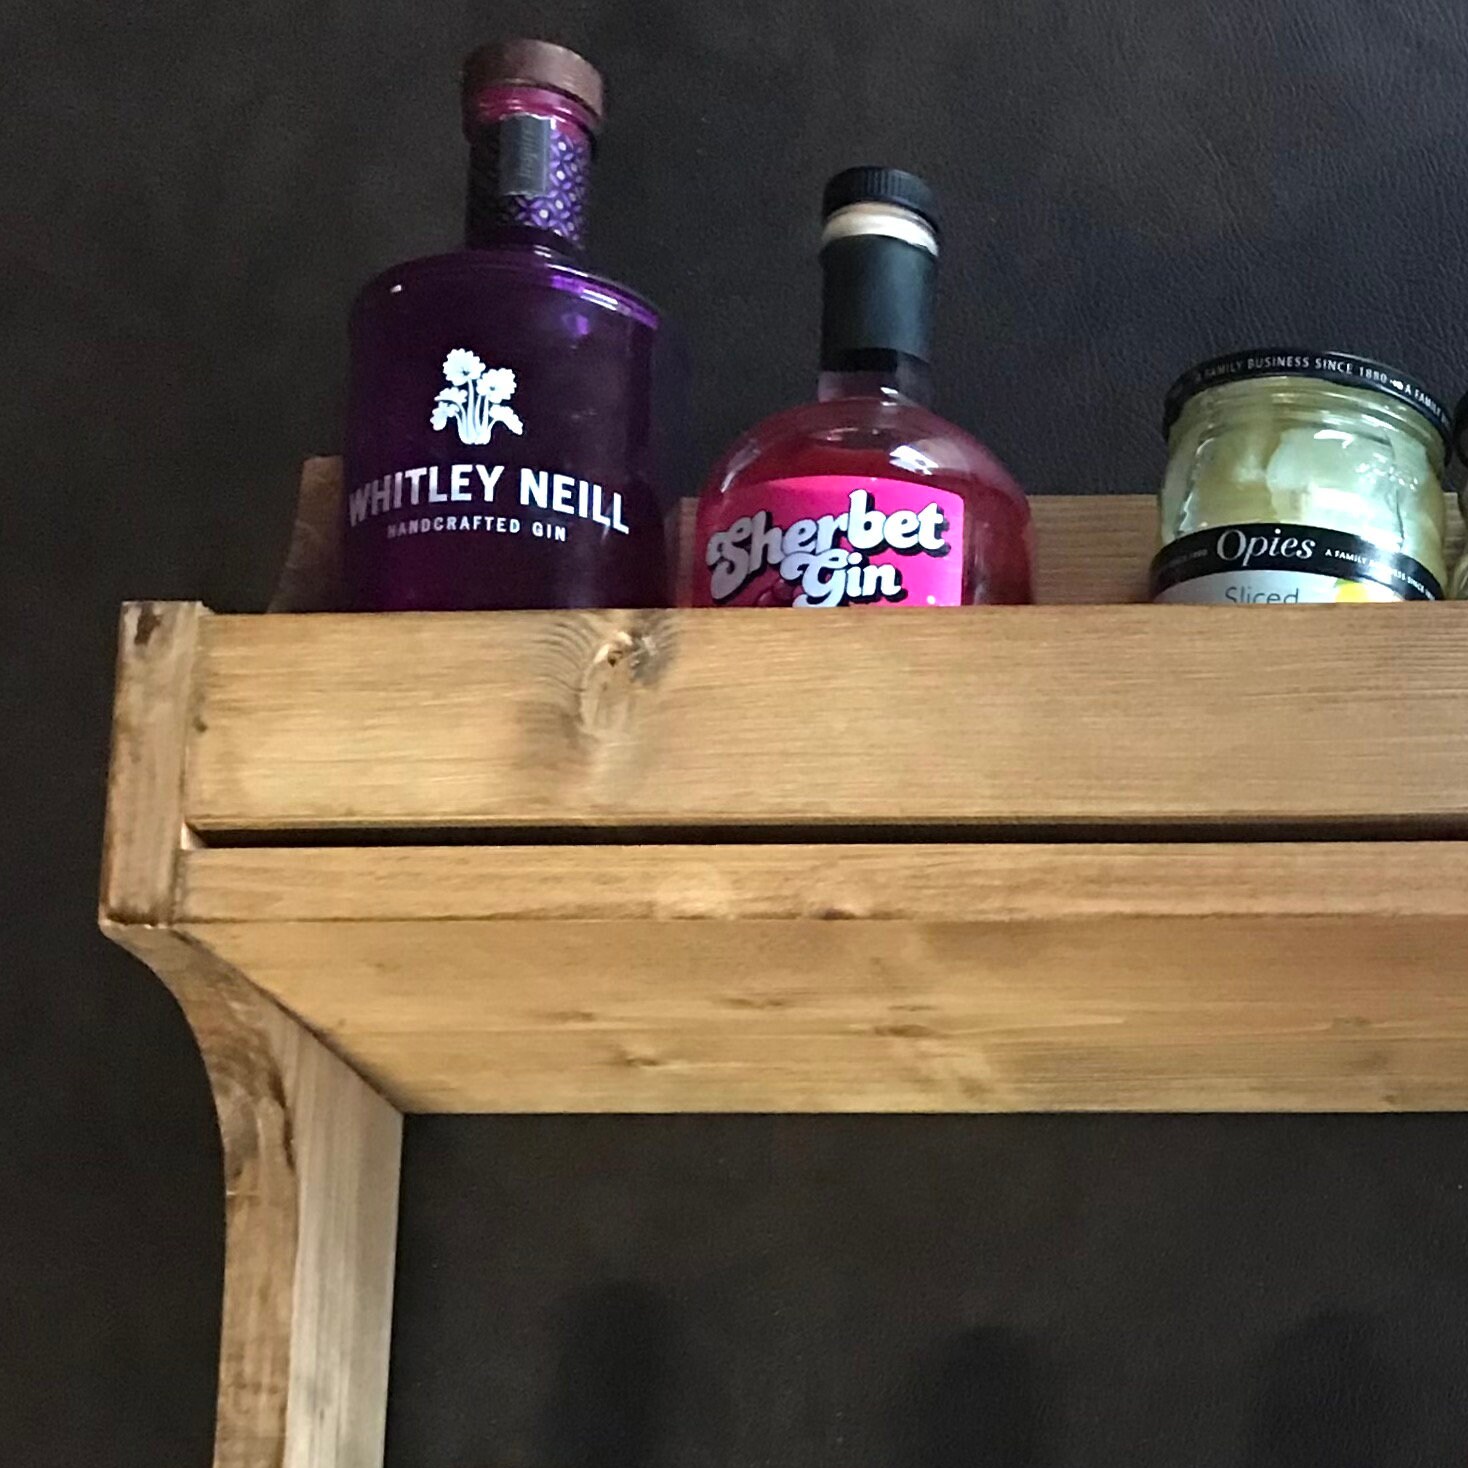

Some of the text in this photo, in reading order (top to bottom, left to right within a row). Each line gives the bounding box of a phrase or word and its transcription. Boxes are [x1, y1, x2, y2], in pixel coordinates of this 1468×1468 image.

[1247, 355, 1310, 370] BUSINESS
[1315, 357, 1353, 375] SINCE
[350, 463, 630, 535] WHITLEY NEILL
[387, 515, 566, 542] HANDCRAFTED GIN
[705, 488, 951, 600] Sherbet
[1216, 528, 1317, 566] Opies
[1324, 548, 1333, 557] A
[780, 547, 908, 608] Gin
[1224, 586, 1299, 605] Sliced
